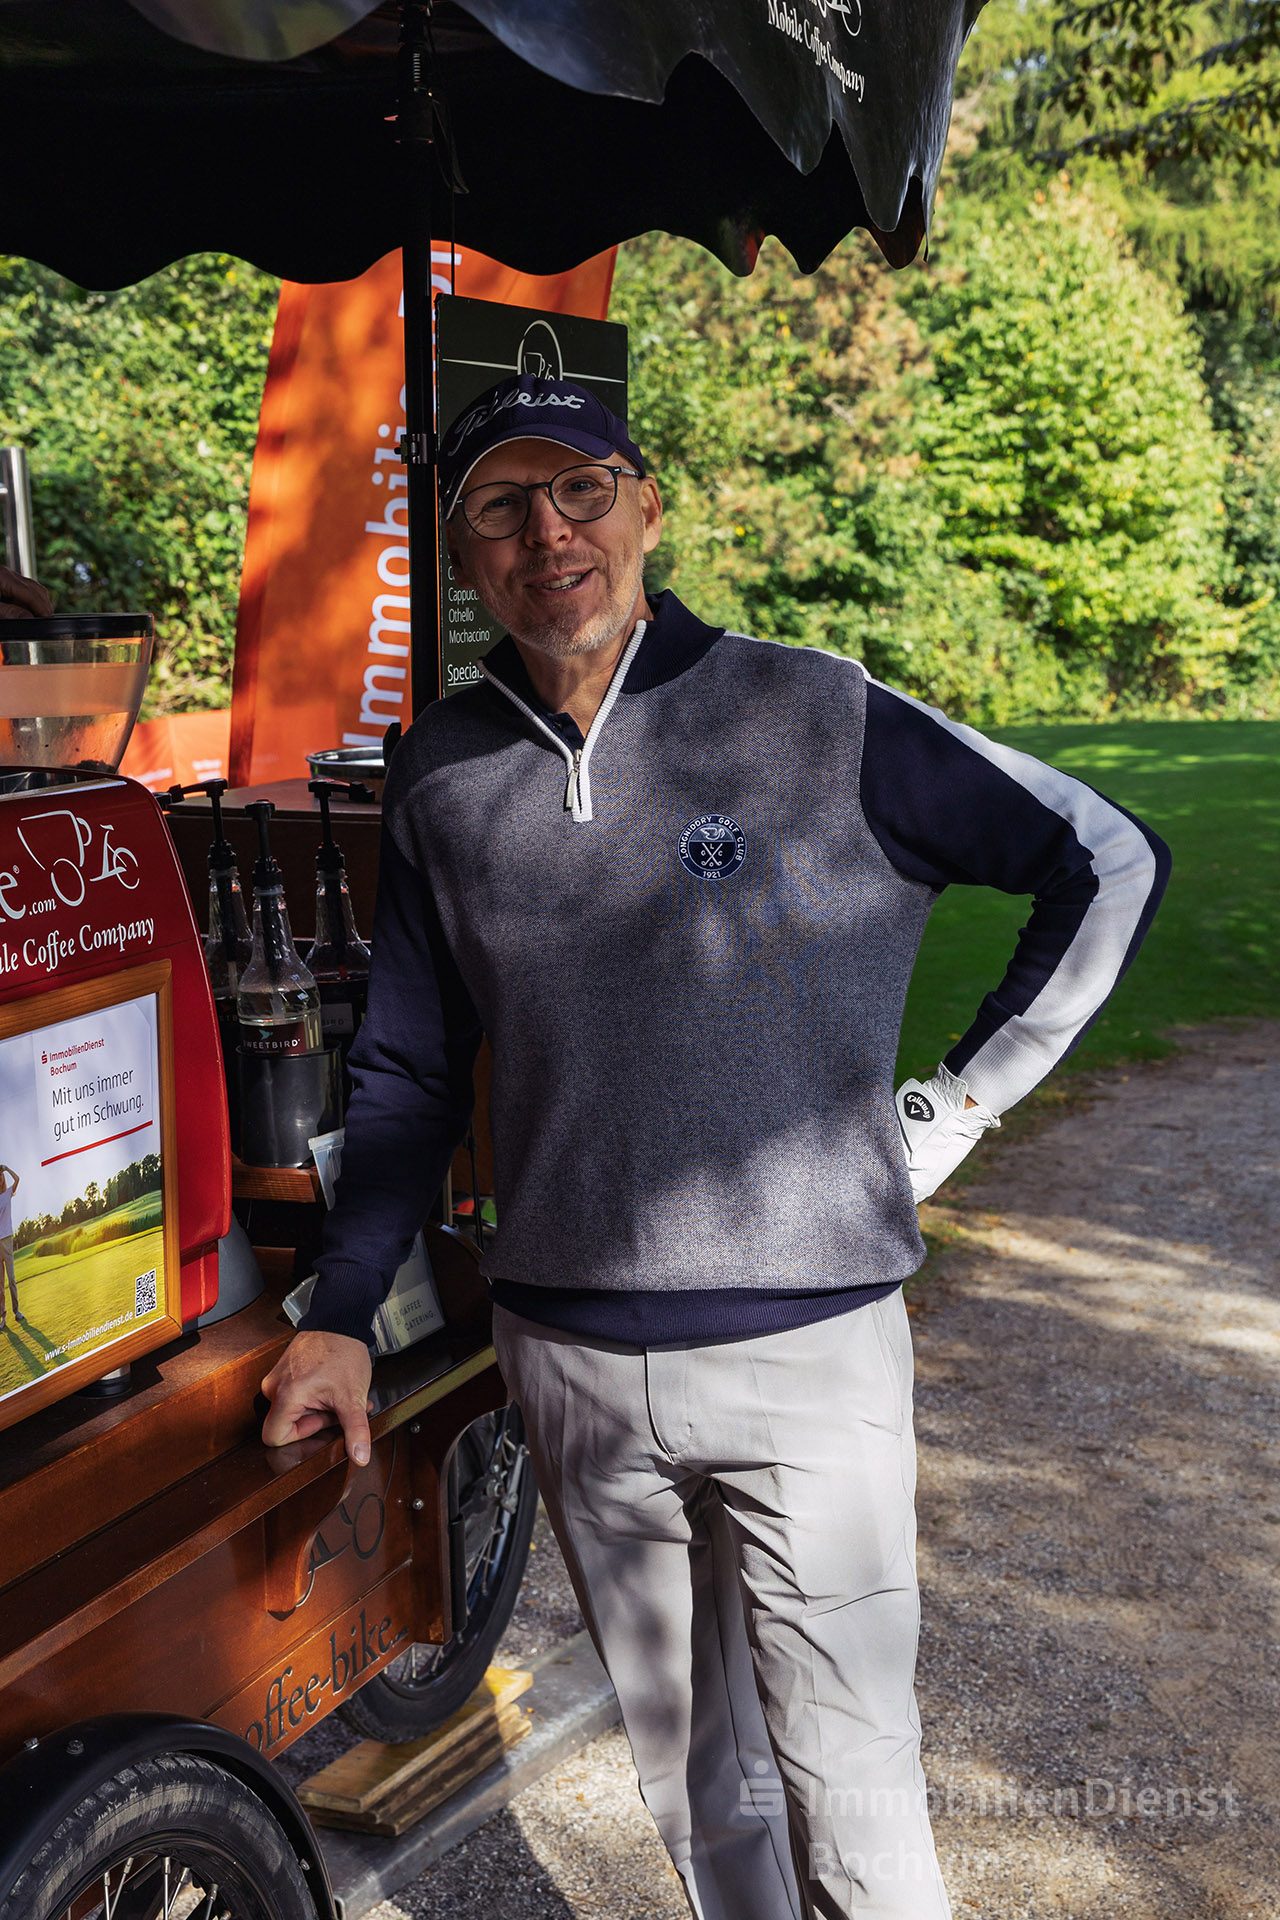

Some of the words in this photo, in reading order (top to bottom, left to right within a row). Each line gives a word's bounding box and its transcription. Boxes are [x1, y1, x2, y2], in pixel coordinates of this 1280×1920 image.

[768, 0, 803, 43] Mobile
[680, 816, 712, 859] LONGNIDDRY
[718, 817, 740, 833] GOLF
[735, 836, 745, 861] CLUB
[702, 870, 721, 879] 1921
[22, 930, 76, 972] Coffee
[79, 917, 154, 952] Company
[49, 1038, 105, 1062] ImmobilienDienst
[50, 1061, 77, 1077] Bochum
[52, 1088, 72, 1108] Mit
[75, 1082, 95, 1101] uns
[97, 1069, 134, 1093] immer
[906, 1094, 931, 1119] Callaway
[53, 1115, 75, 1142] gut
[77, 1111, 91, 1129] im
[93, 1094, 144, 1123] Schwung.
[44, 1311, 134, 1362] www.s-immobiliendienst.de
[246, 1608, 394, 1752] offee-bike
